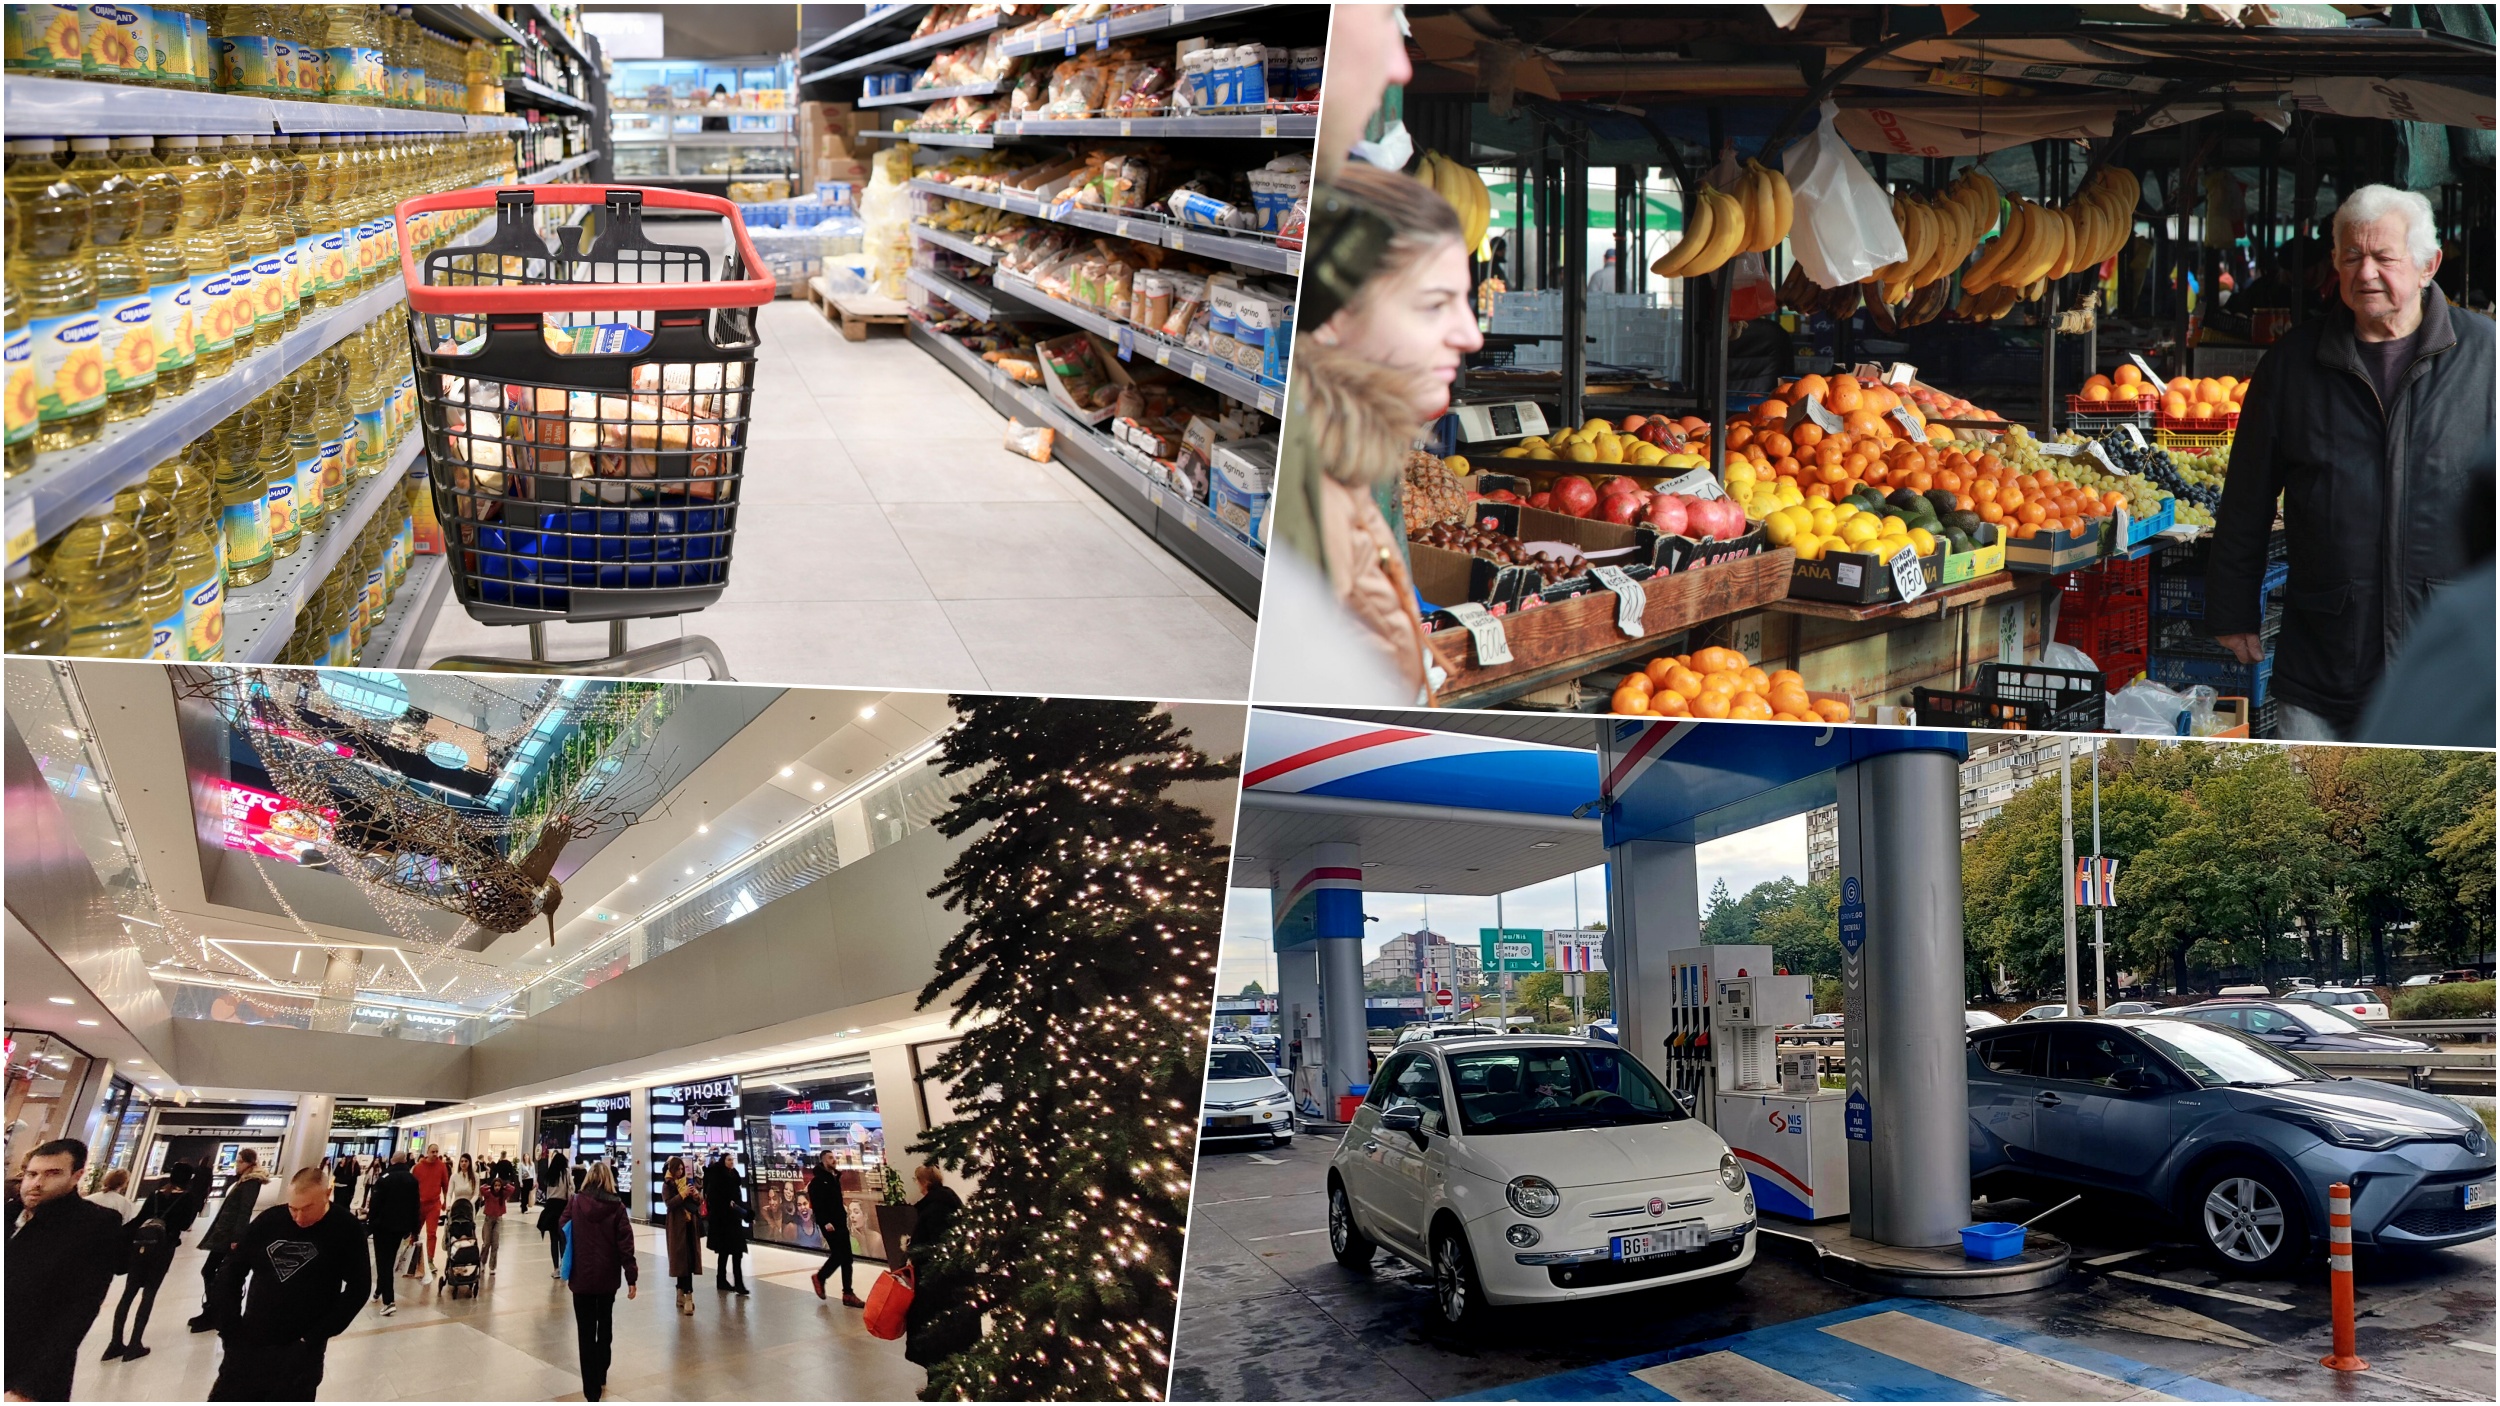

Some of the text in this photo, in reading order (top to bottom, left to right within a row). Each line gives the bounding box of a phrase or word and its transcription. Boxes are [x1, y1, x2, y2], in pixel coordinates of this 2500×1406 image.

[1240, 305, 1259, 319] Agrino
[1223, 460, 1245, 480] Agrino
[1900, 568, 1922, 598] 250
[1744, 630, 1760, 652] 349
[230, 787, 281, 812] KFC
[670, 1080, 733, 1102] SEPHORA
[813, 1101, 830, 1110] HUB
[1787, 1114, 1801, 1125] NIS
[767, 1169, 803, 1179] SEPHORA
[2470, 1187, 2478, 1202] BG
[1652, 1202, 1662, 1213] FIAT
[1623, 1238, 1641, 1256] BG
